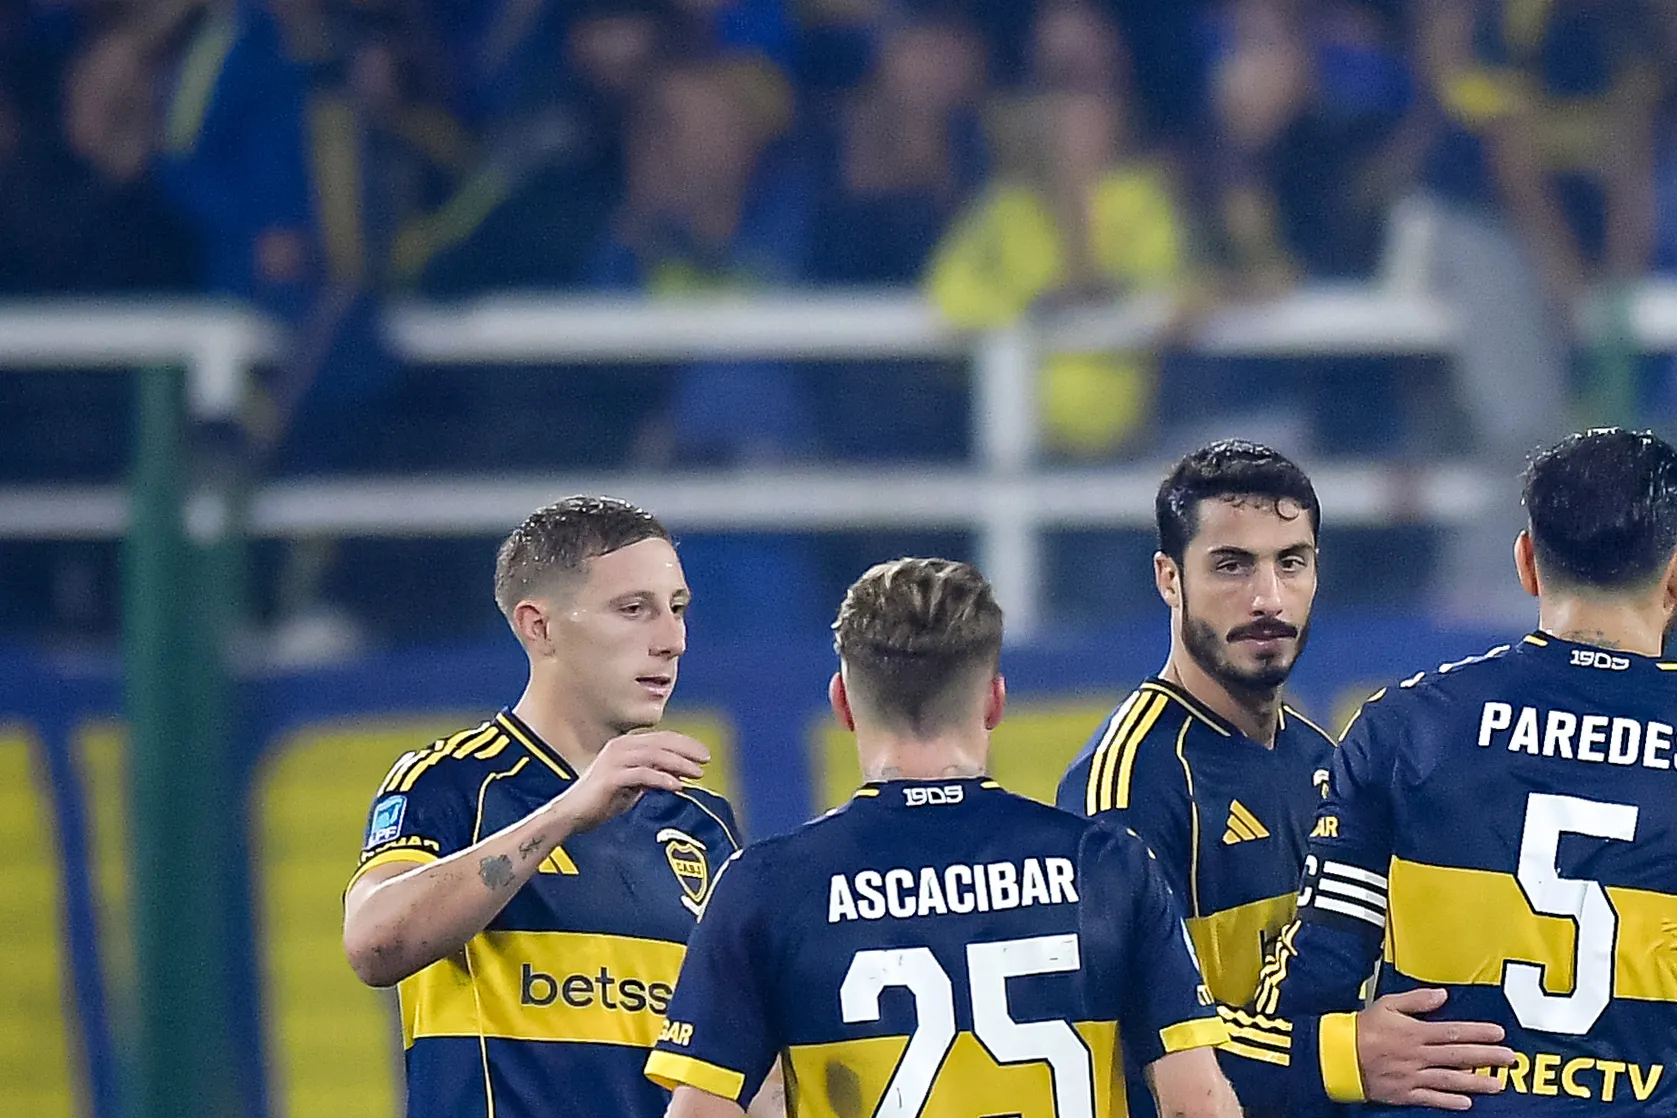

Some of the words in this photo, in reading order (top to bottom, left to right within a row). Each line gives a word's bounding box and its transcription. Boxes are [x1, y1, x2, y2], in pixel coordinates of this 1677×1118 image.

[903, 785, 964, 806] 1905
[828, 858, 1079, 922] ASCACIBAR
[1503, 793, 1639, 1035] 5
